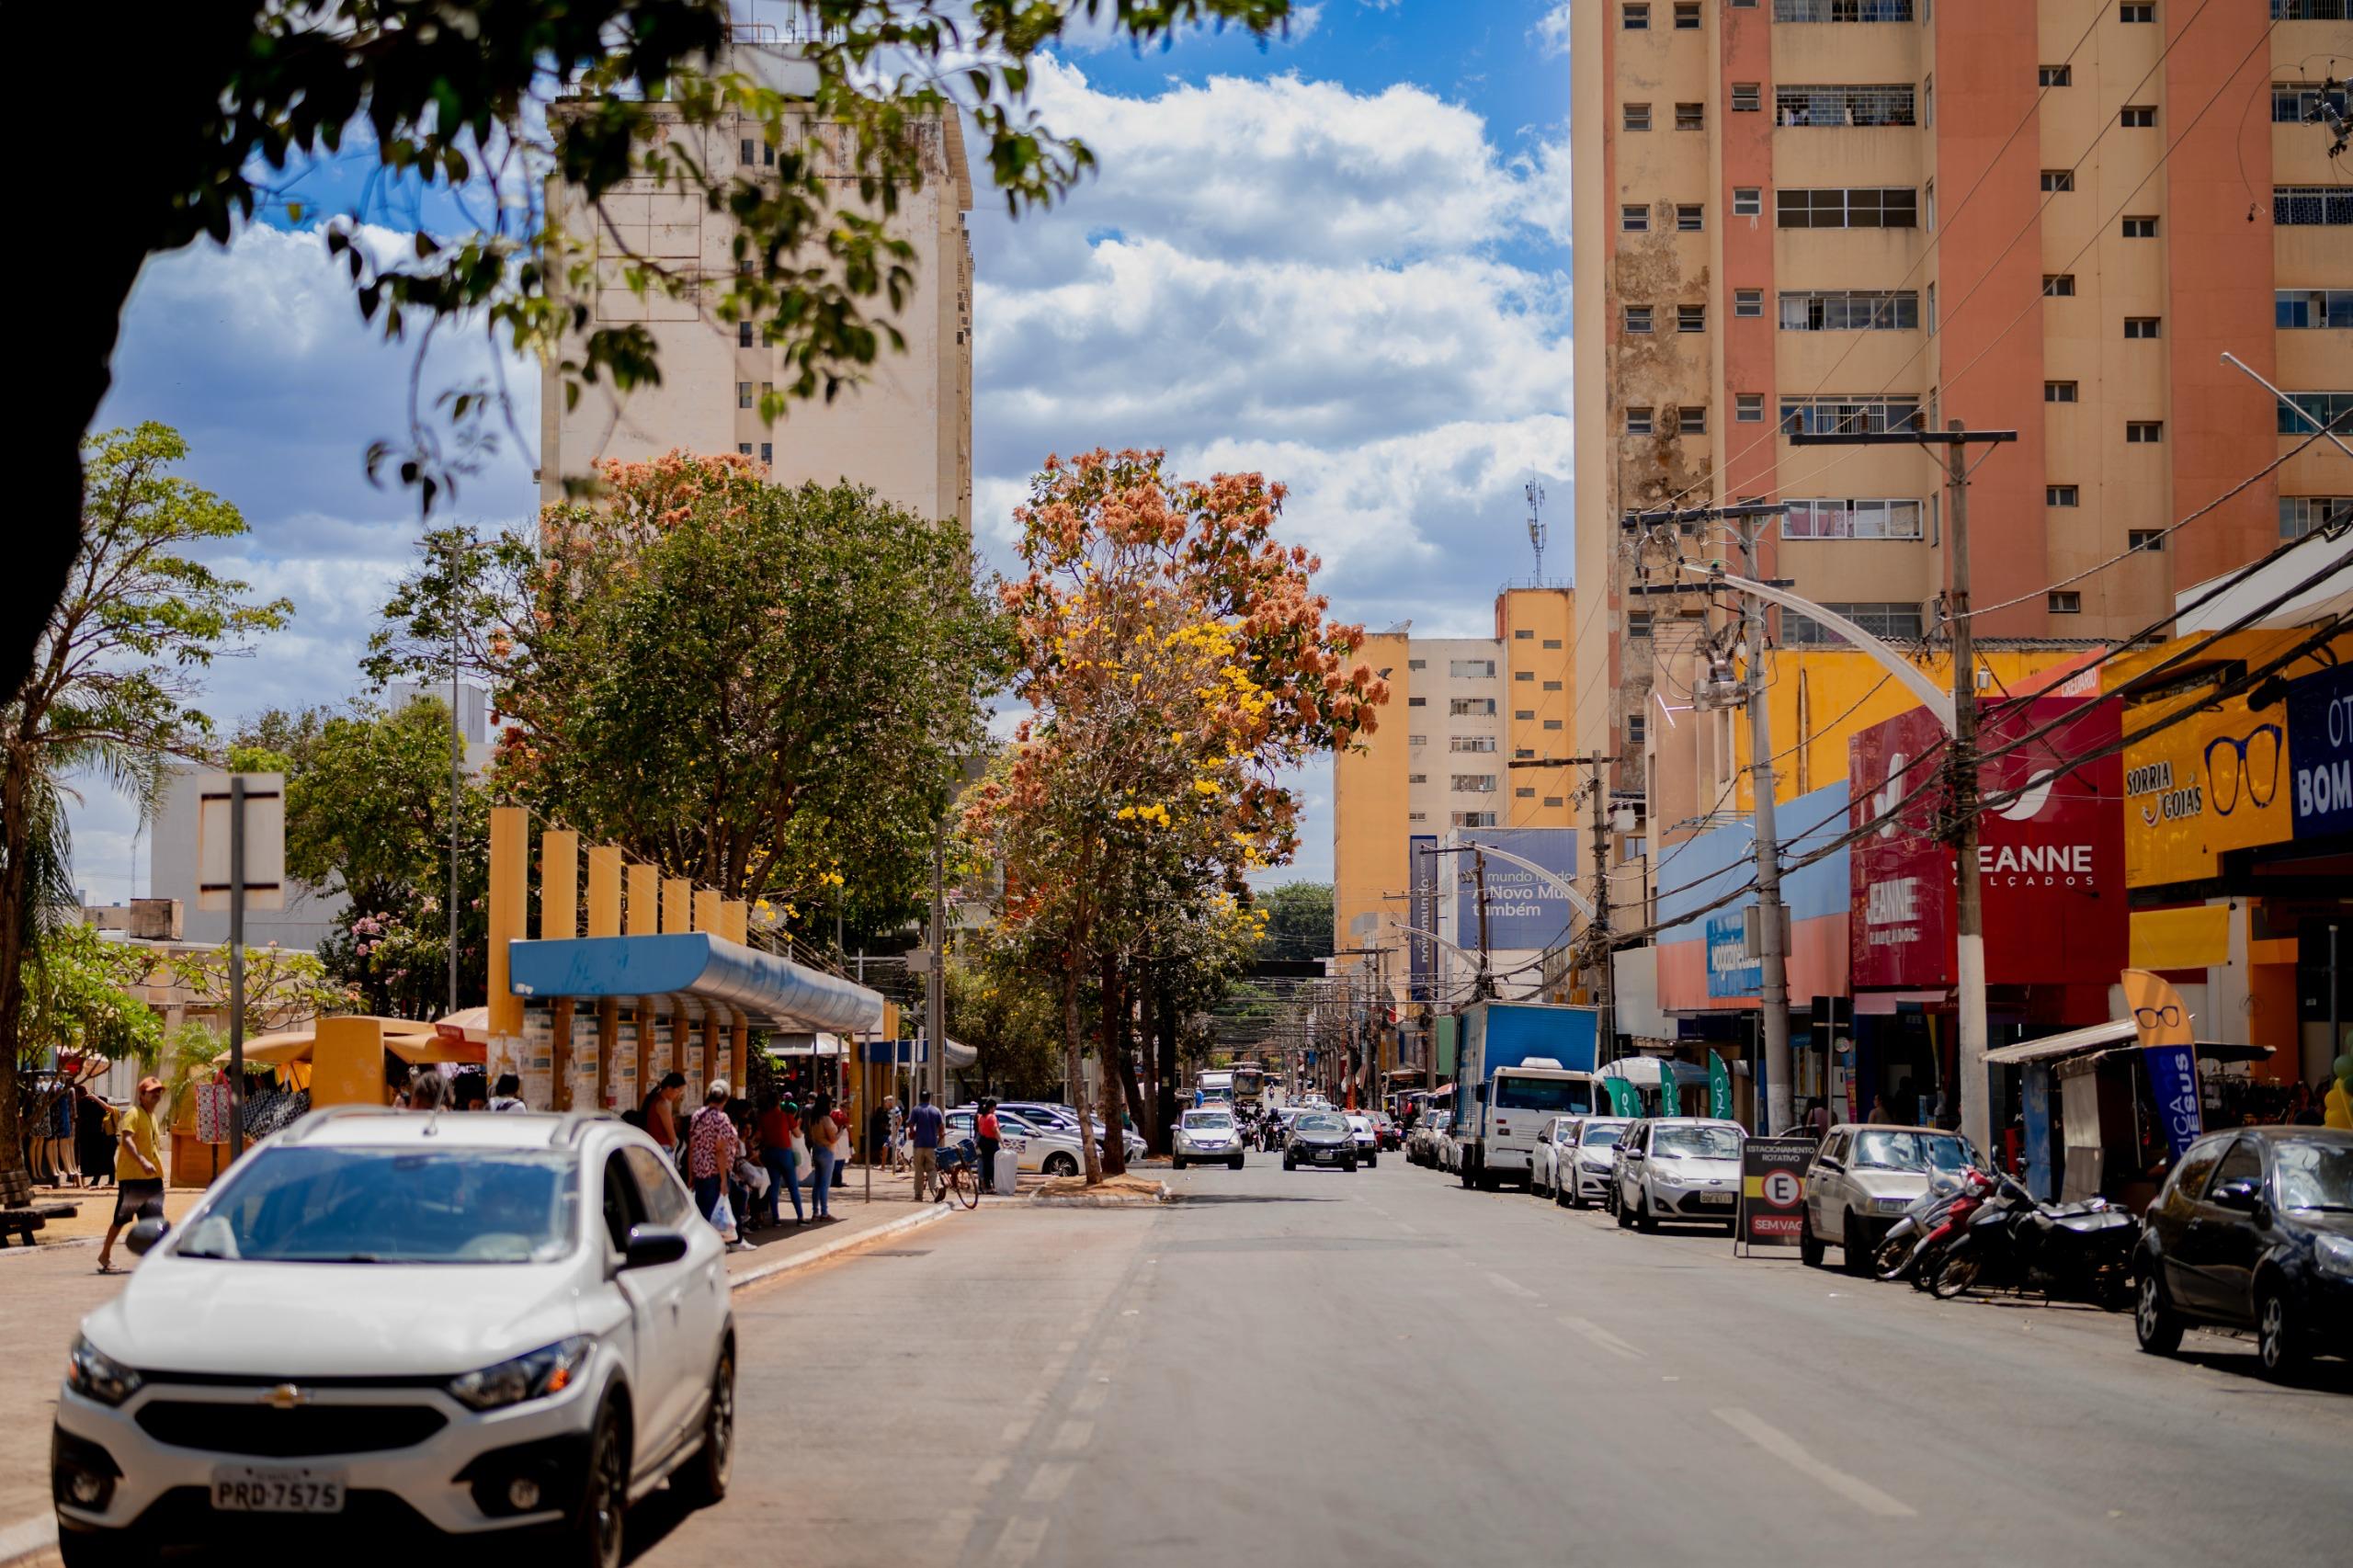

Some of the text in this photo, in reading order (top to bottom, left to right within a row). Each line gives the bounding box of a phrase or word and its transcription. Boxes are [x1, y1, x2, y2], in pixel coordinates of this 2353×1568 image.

[2126, 761, 2172, 797] SORRIA
[2298, 758, 2353, 818] BOM
[2162, 772, 2202, 820] GOIÁS
[1951, 845, 2093, 873] EANNE
[1487, 870, 1532, 882] mundo
[1490, 885, 1533, 900] Novo
[1866, 877, 1920, 925] JEANNE
[1472, 902, 1540, 917] tmbém
[2175, 1052, 2200, 1146] ESUS
[2169, 1095, 2193, 1158] TICA
[1746, 1145, 1815, 1154] ESTACIONAMENTO
[1761, 1153, 1801, 1163] ROTATIVO
[1774, 1177, 1790, 1199] E
[1755, 1219, 1803, 1231] SEM VAG
